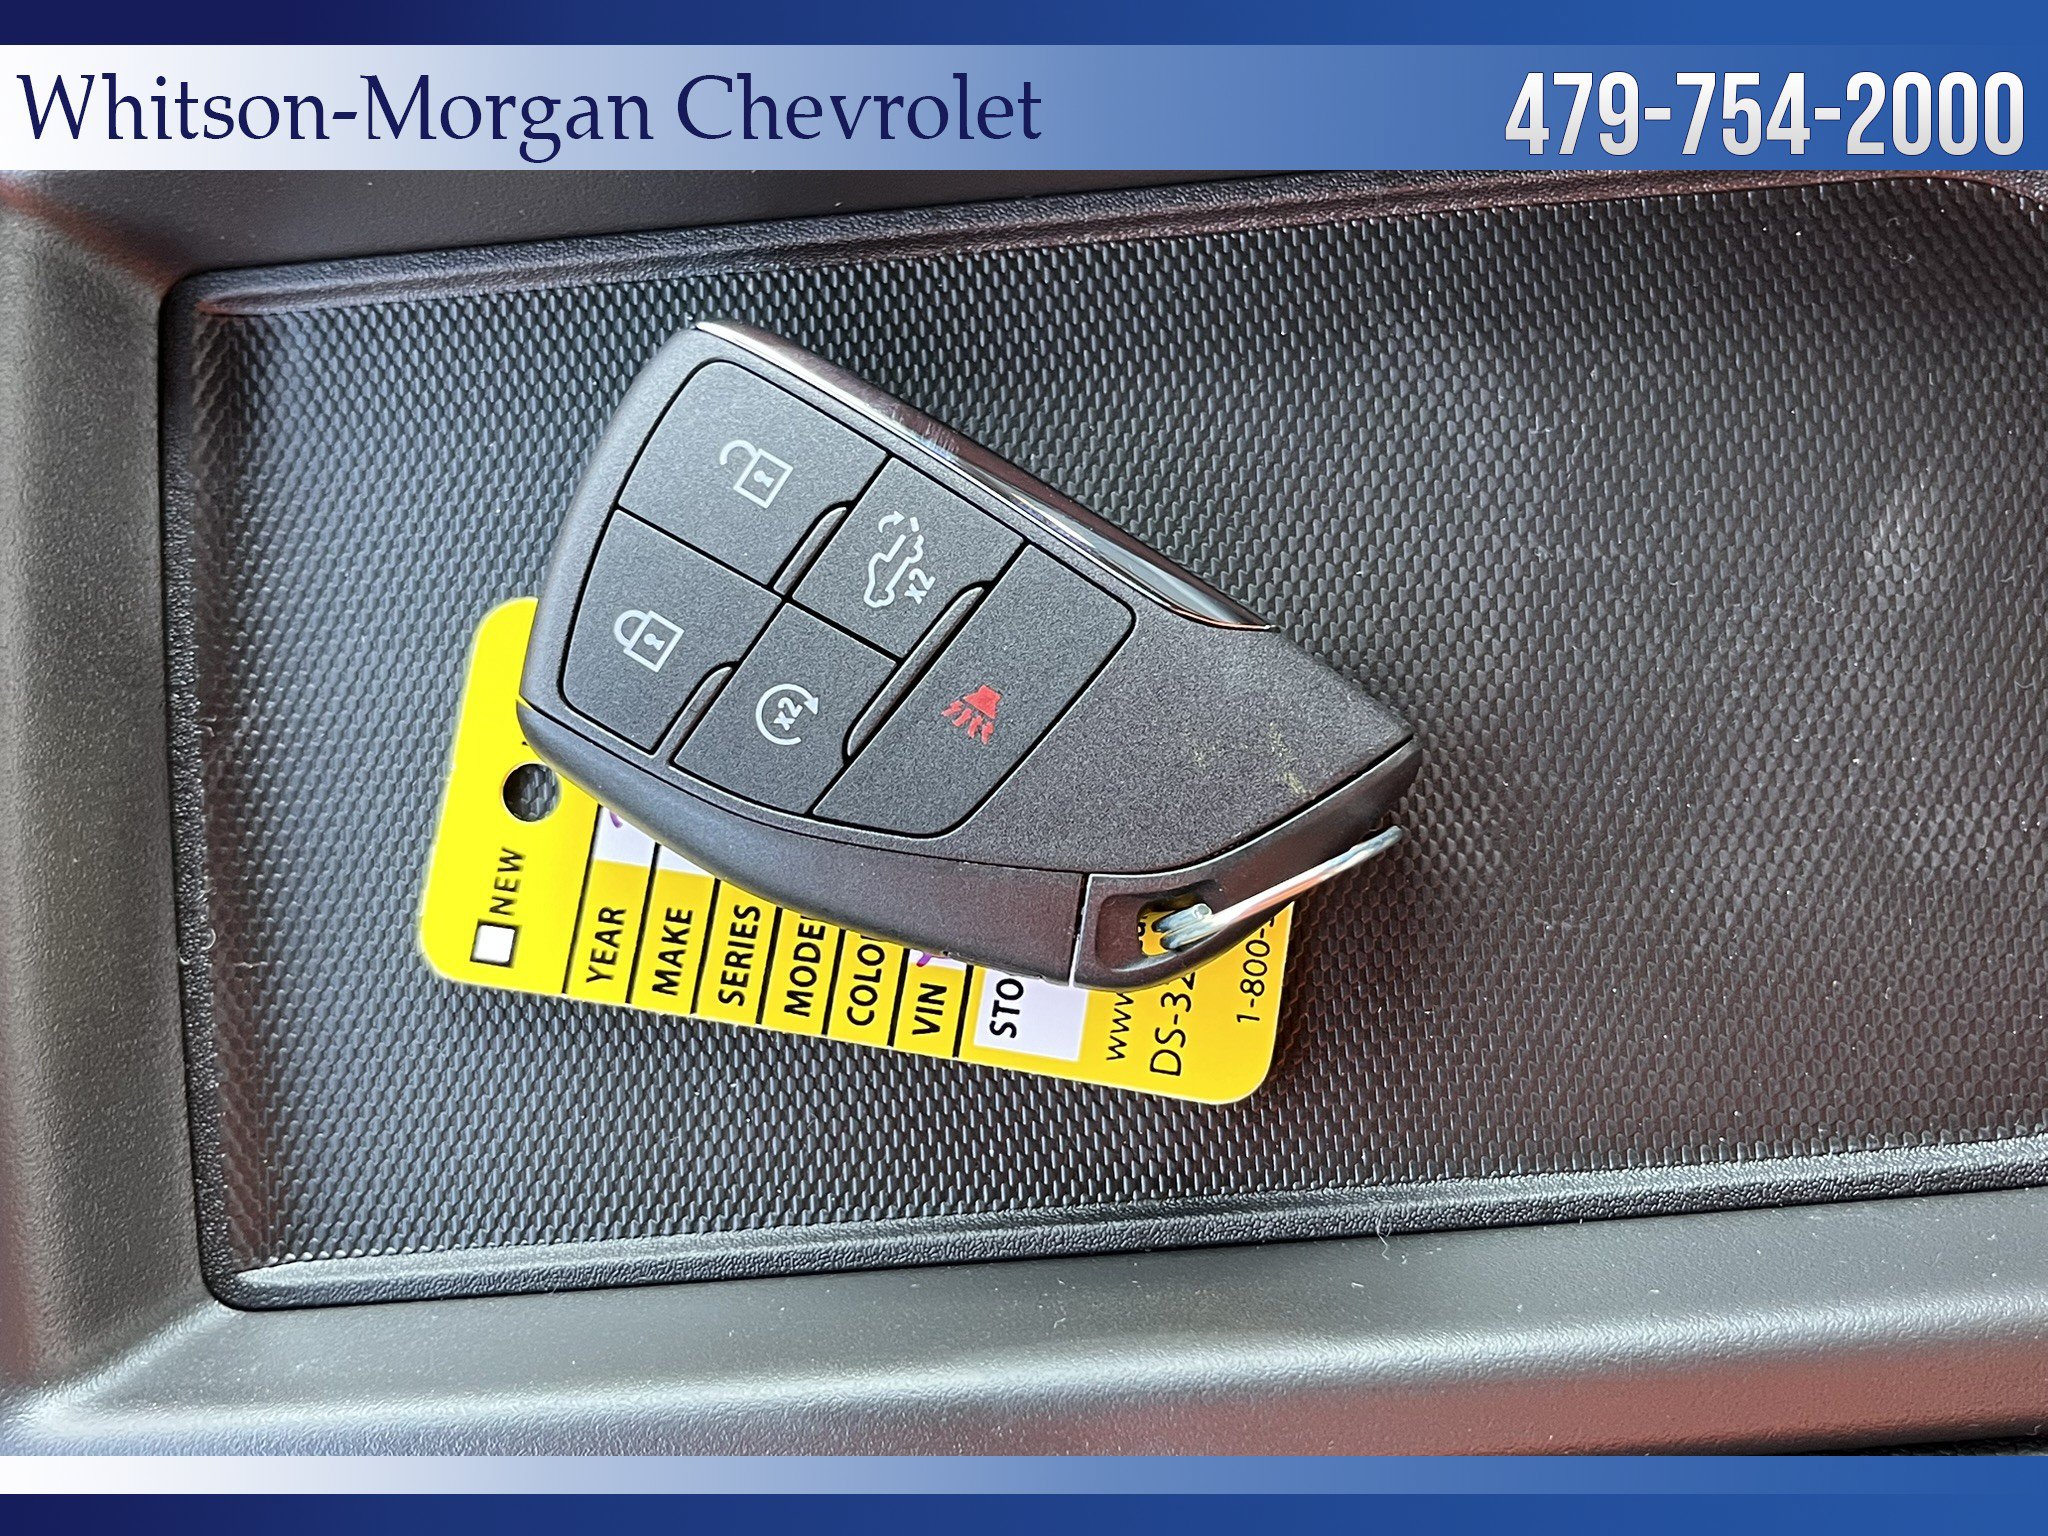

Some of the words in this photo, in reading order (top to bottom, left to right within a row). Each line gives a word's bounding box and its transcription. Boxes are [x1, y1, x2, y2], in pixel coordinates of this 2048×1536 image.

[490, 846, 526, 915] NEW
[585, 905, 627, 983] YEAR
[652, 906, 693, 996] MAKE
[718, 904, 761, 1007] SERIES
[784, 916, 825, 1017] MODE
[846, 935, 885, 1026] COLO
[1236, 917, 1276, 1023] 1-800-
[912, 982, 947, 1035] VIN
[989, 978, 1024, 1038] STO
